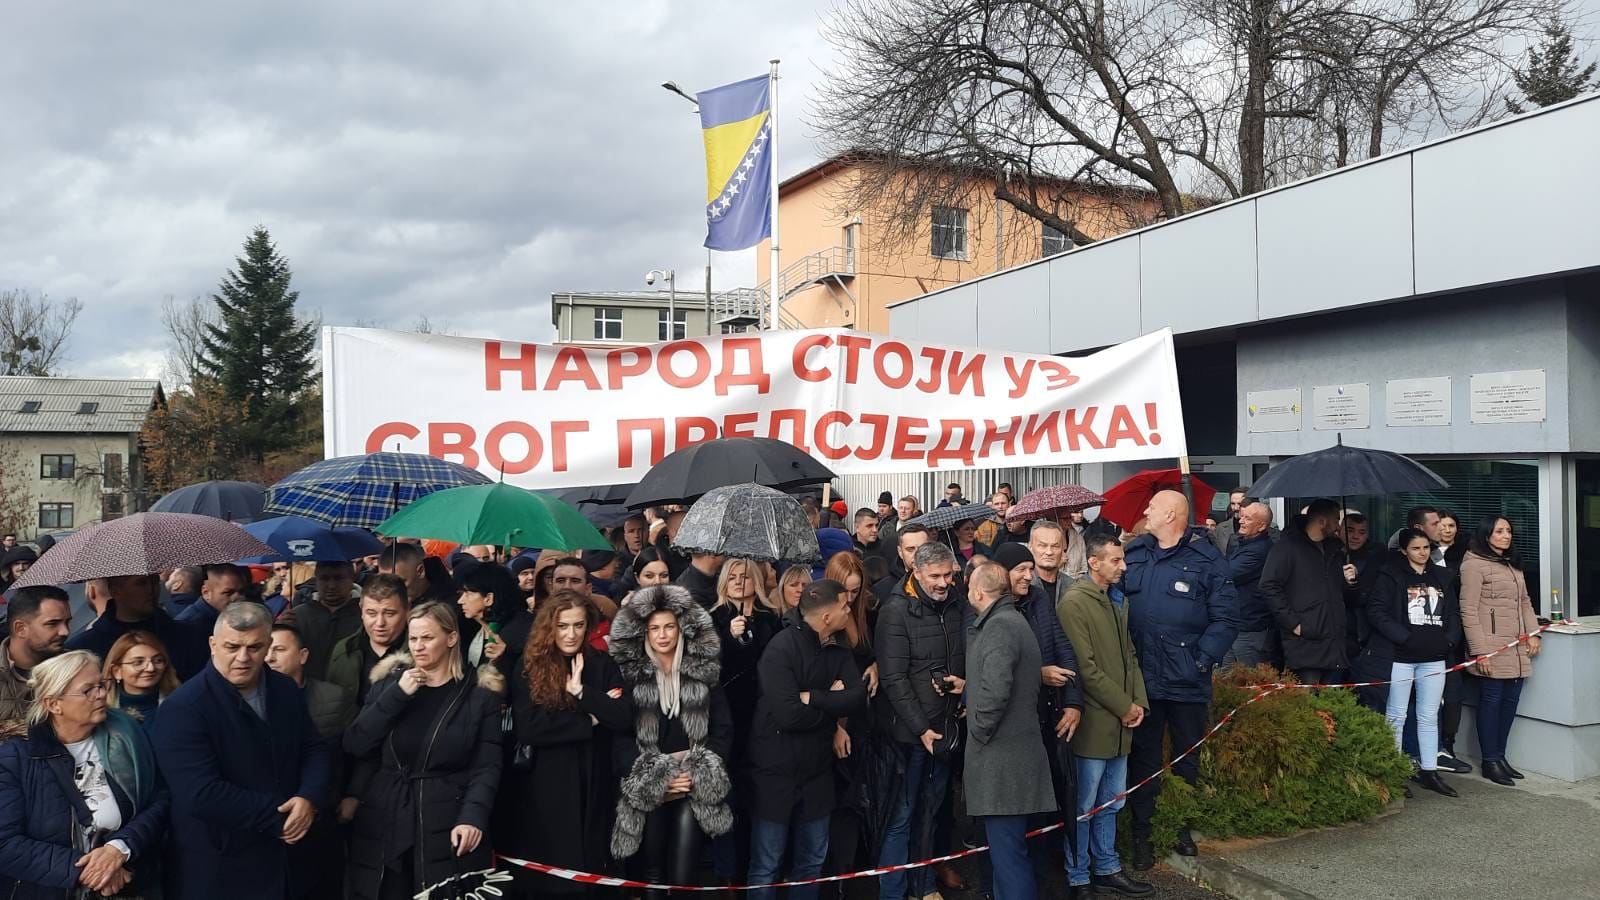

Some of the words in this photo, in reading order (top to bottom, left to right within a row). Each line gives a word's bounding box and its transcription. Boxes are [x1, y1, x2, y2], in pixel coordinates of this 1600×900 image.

[485, 338, 770, 395] НАРОД
[792, 335, 985, 397] СТОЈИ
[1004, 356, 1078, 398] УЗ
[366, 420, 588, 474] СВОГ
